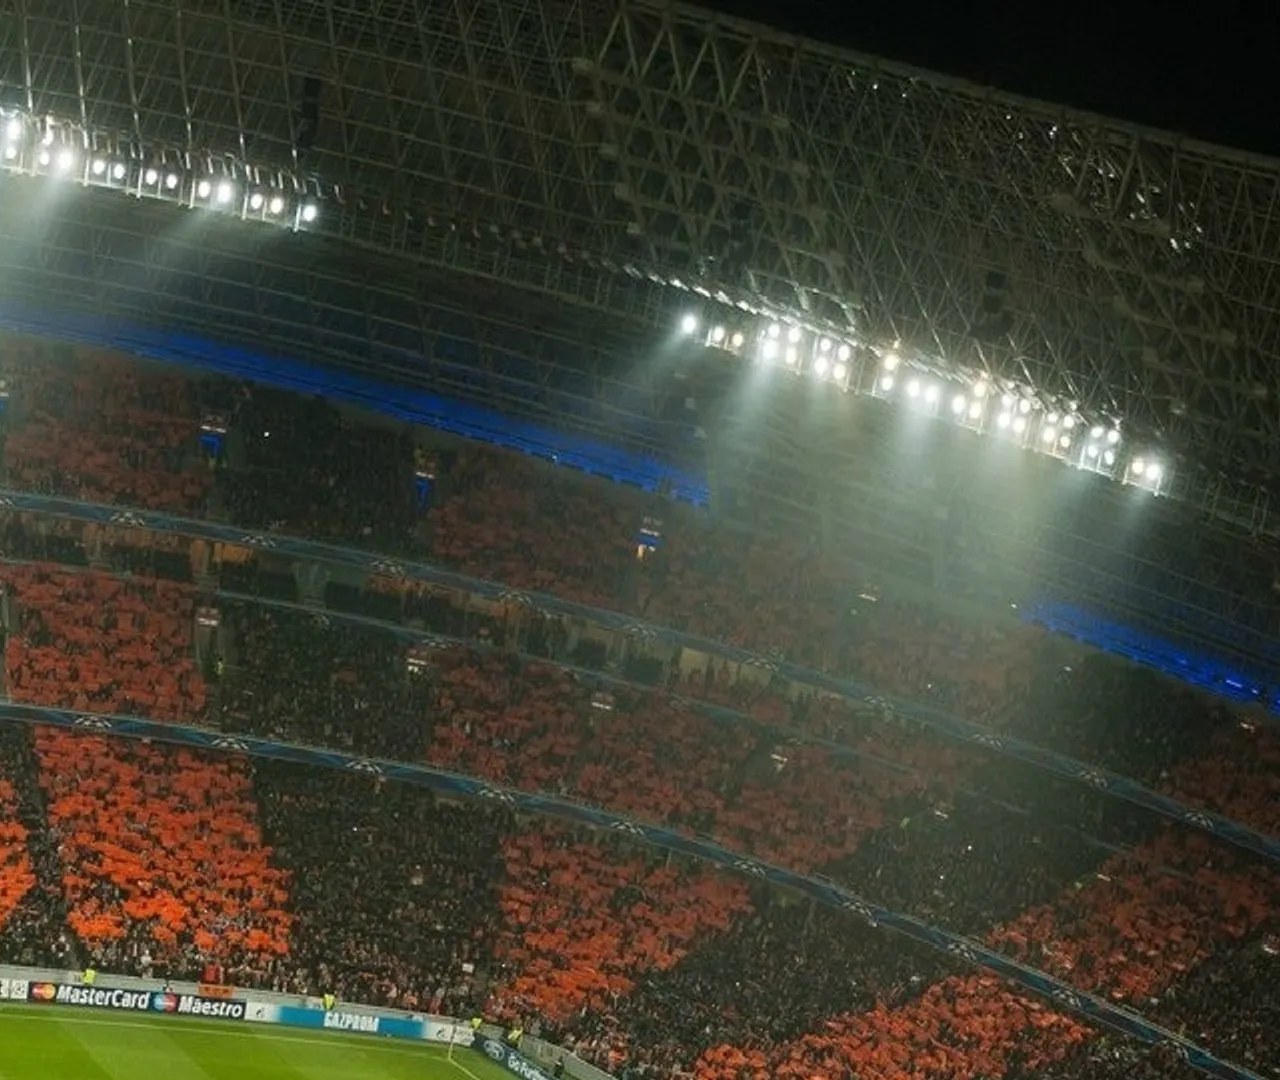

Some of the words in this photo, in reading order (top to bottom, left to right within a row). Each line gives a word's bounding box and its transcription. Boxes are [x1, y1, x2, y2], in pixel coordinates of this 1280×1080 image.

[56, 984, 151, 1009] MasterCard
[178, 996, 244, 1018] Maestro
[323, 1011, 380, 1033] GAZPROM
